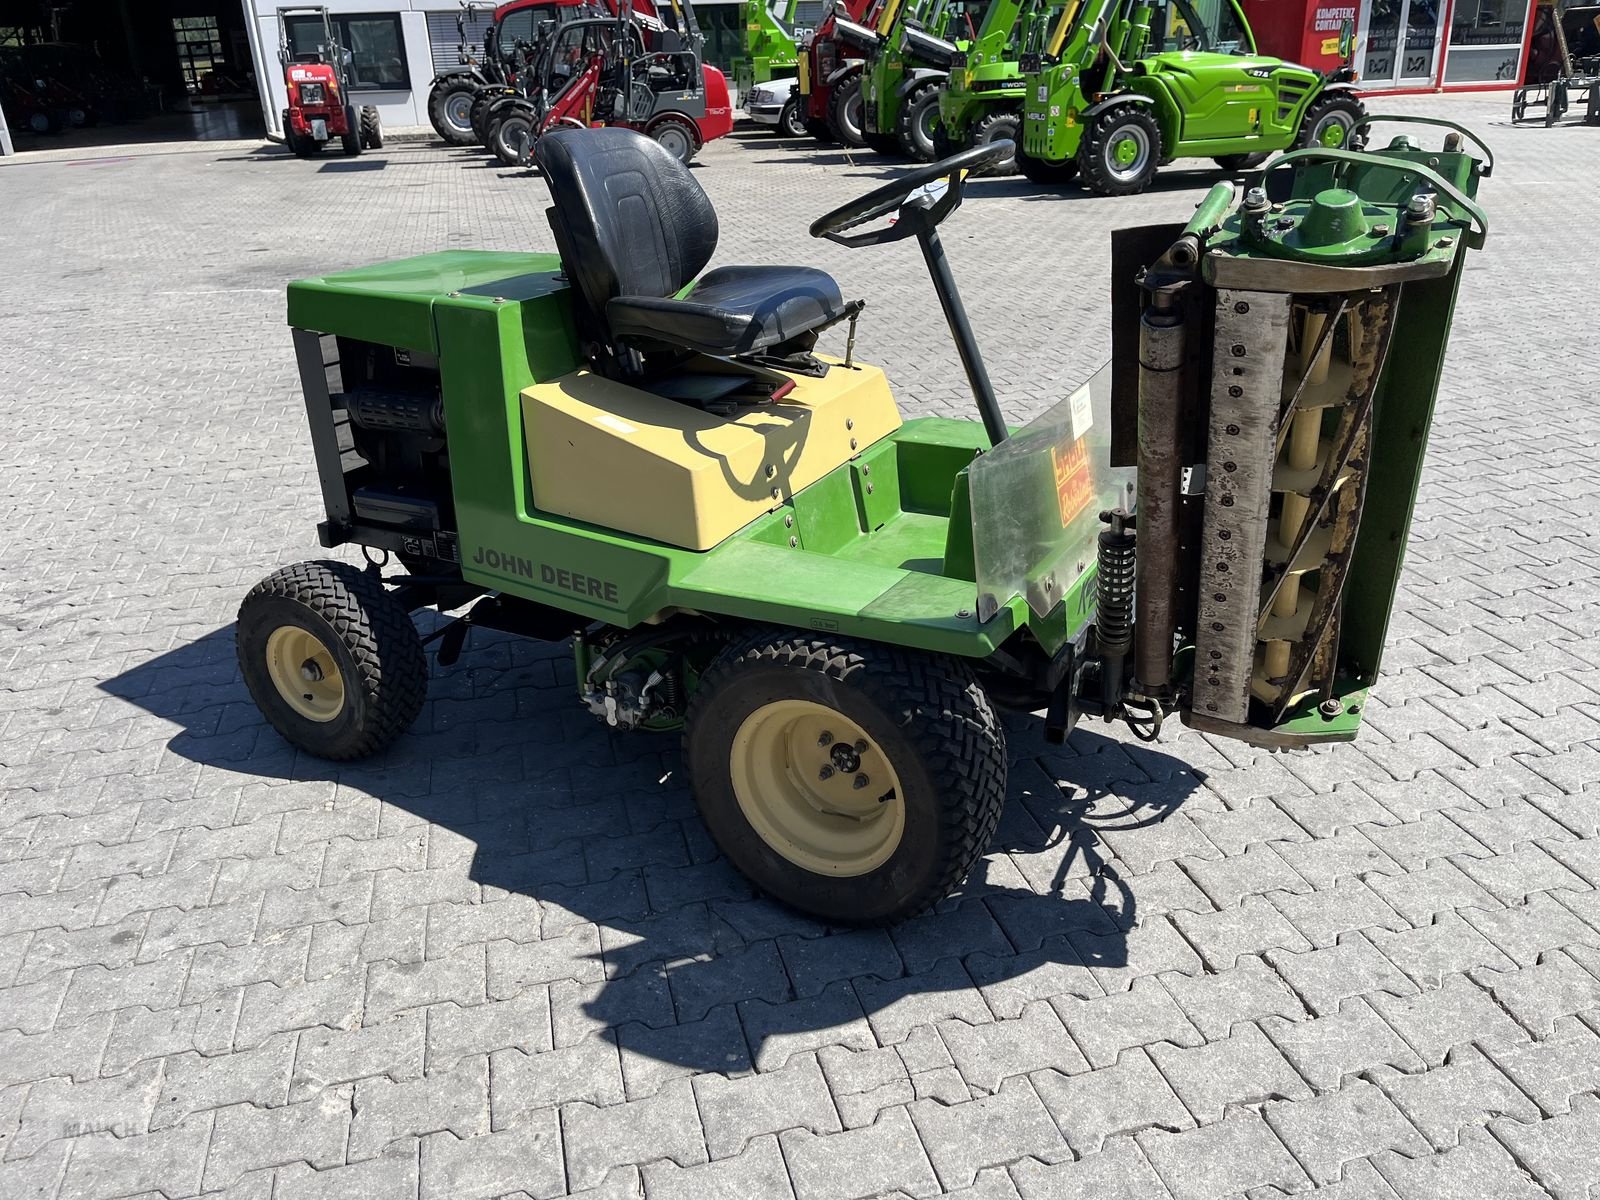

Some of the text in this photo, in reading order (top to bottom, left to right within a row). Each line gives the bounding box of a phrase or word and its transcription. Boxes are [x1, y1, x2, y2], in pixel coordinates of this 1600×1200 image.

[1316, 7, 1355, 19] KOMPETENZ
[1027, 112, 1046, 121] MERLO
[472, 546, 534, 579] JOHN
[540, 564, 619, 604] DEERE
